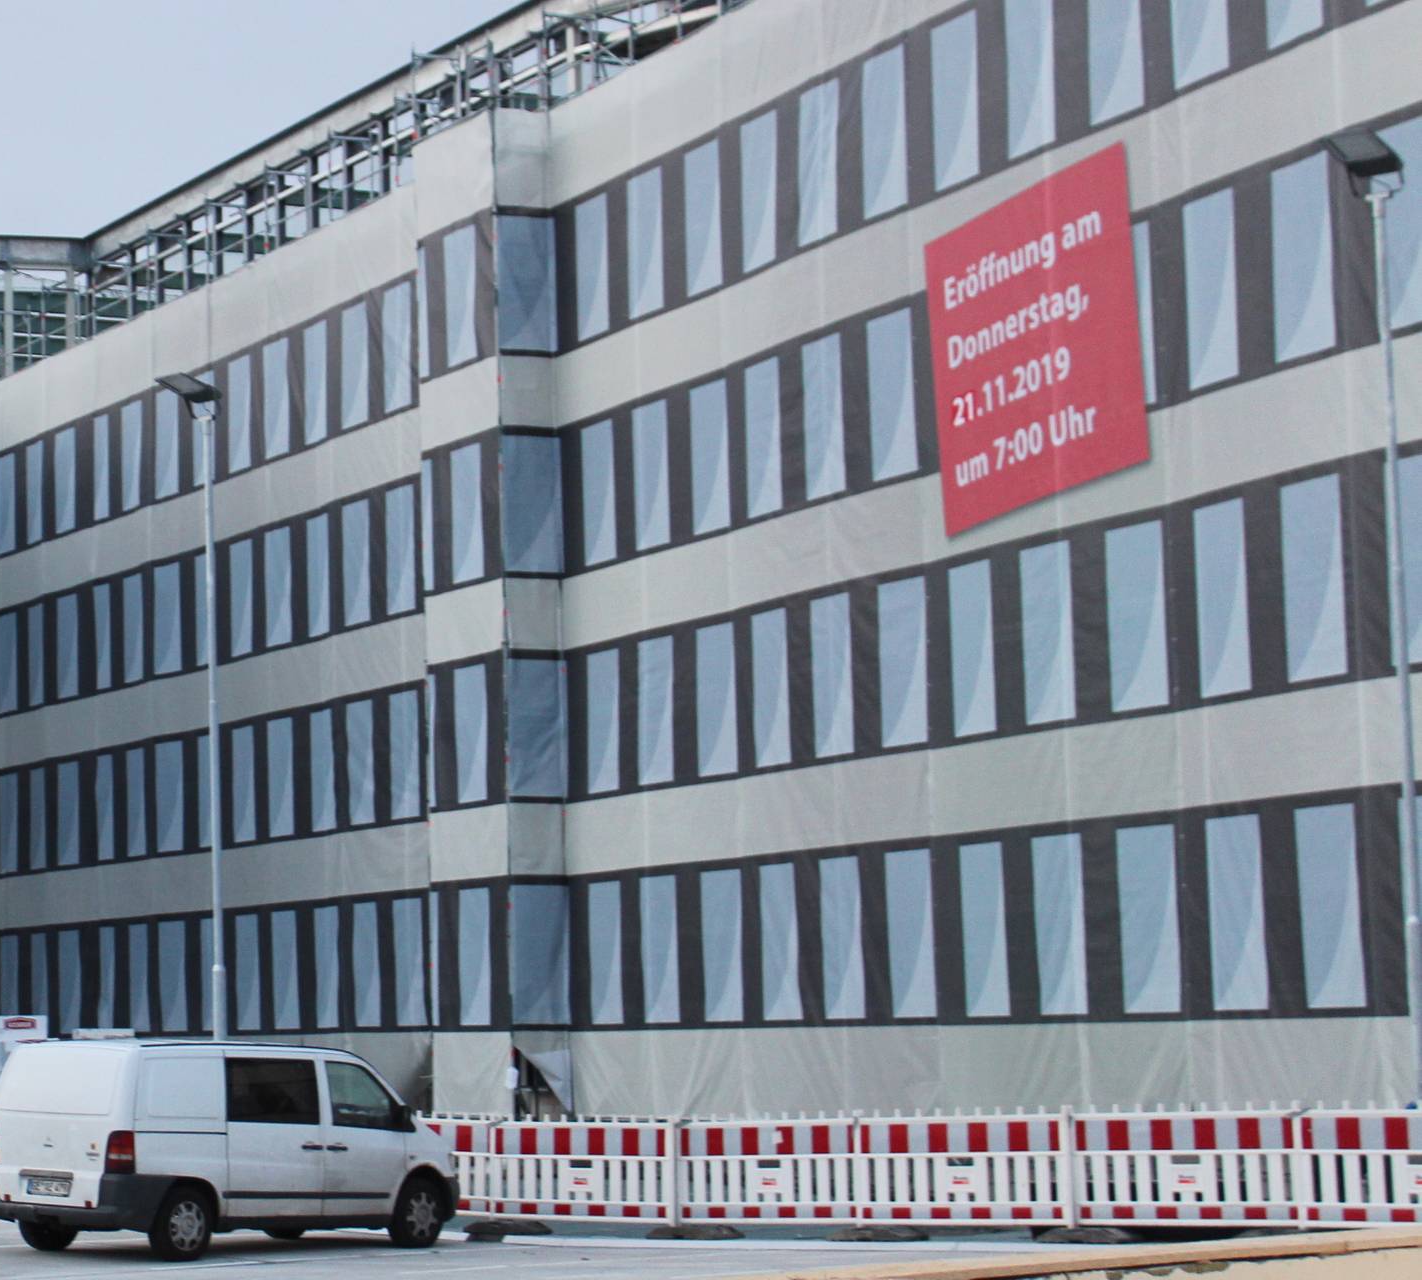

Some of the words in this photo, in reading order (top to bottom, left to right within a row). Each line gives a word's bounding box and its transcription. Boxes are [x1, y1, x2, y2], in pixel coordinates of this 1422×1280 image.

[944, 231, 1055, 310] Eröffnung
[1062, 211, 1102, 249] am
[948, 283, 1089, 369] Donnerstag,
[952, 346, 1071, 427] 21.11.2019
[955, 453, 990, 487] um
[993, 422, 1043, 470] 7:00
[1049, 405, 1096, 447] Uhr
